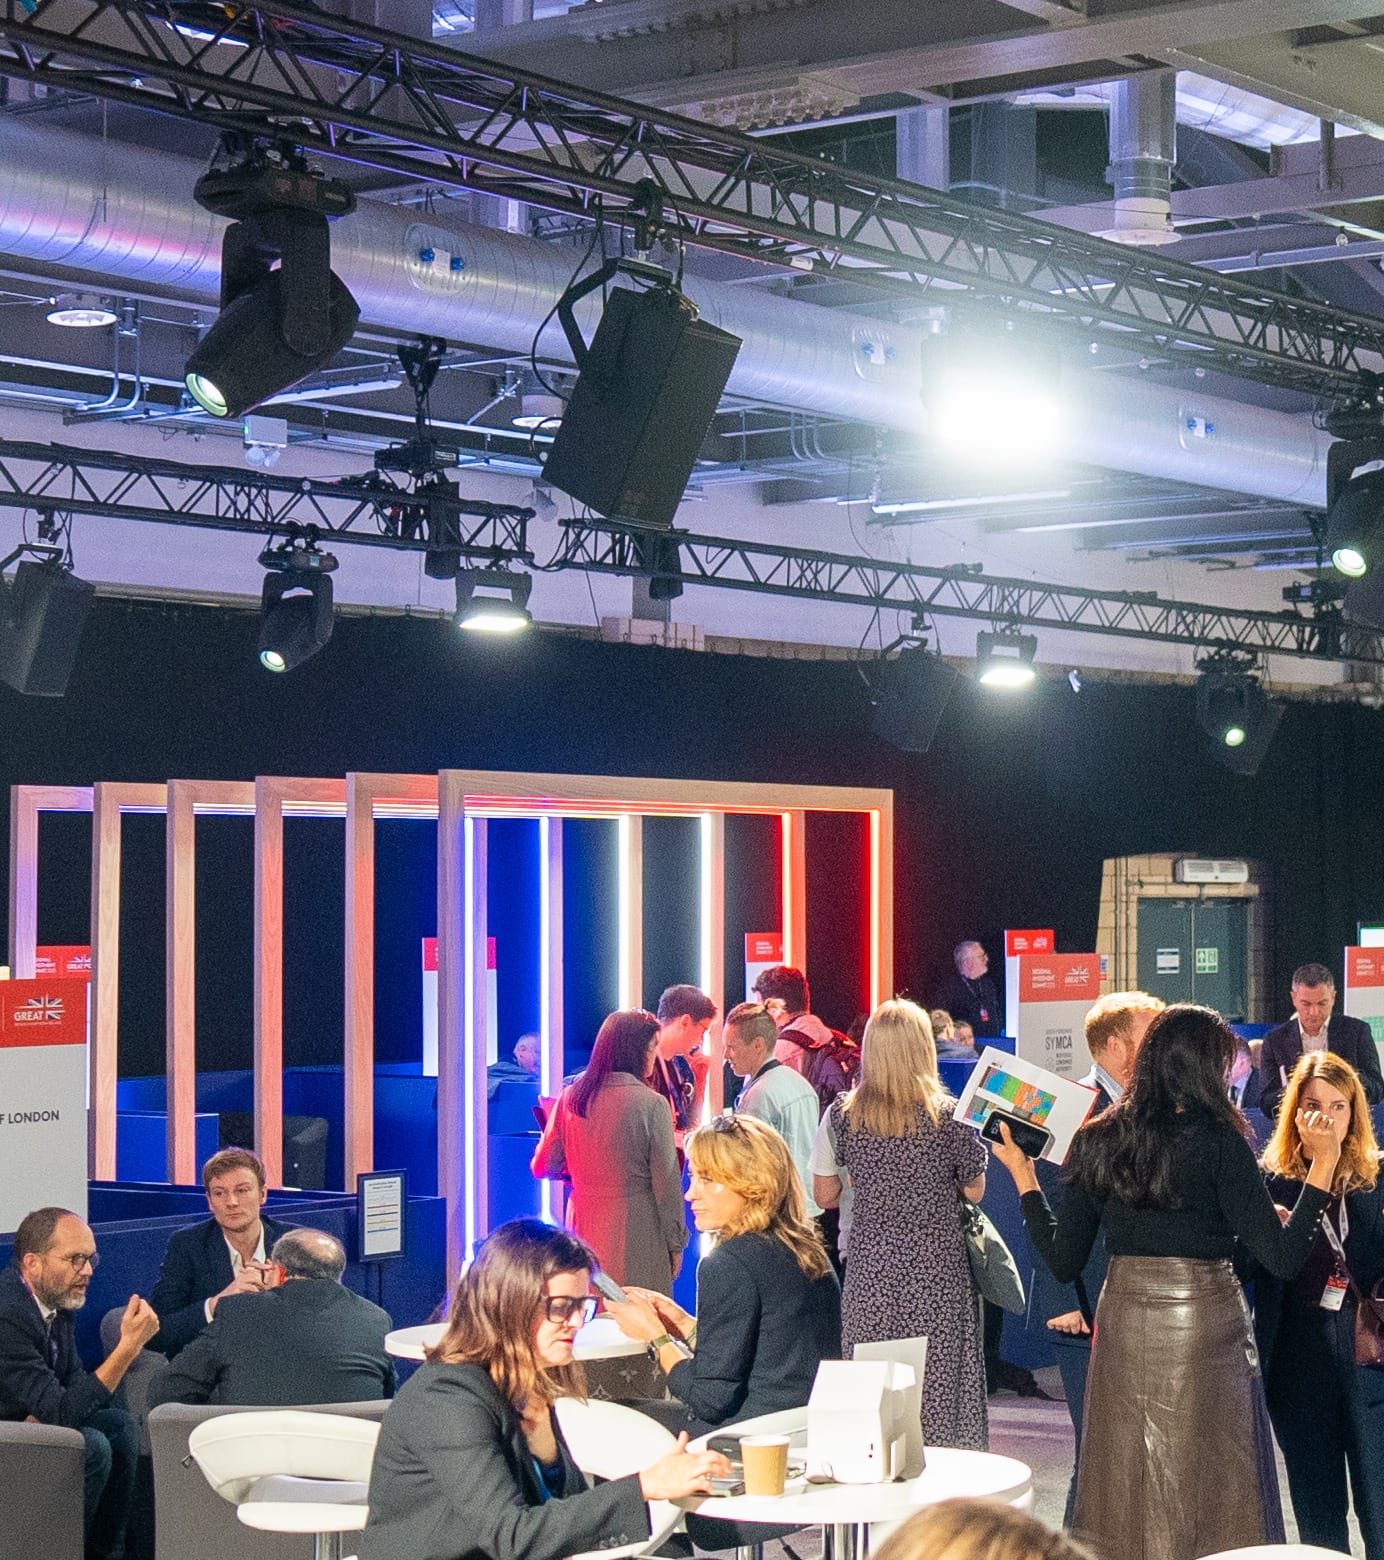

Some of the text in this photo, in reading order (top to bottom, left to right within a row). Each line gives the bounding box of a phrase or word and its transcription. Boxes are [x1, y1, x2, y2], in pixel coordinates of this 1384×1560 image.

[13, 1011, 43, 1021] GREAT
[1045, 1035, 1073, 1050] SYMCA
[0, 1110, 60, 1125] F LONDON
